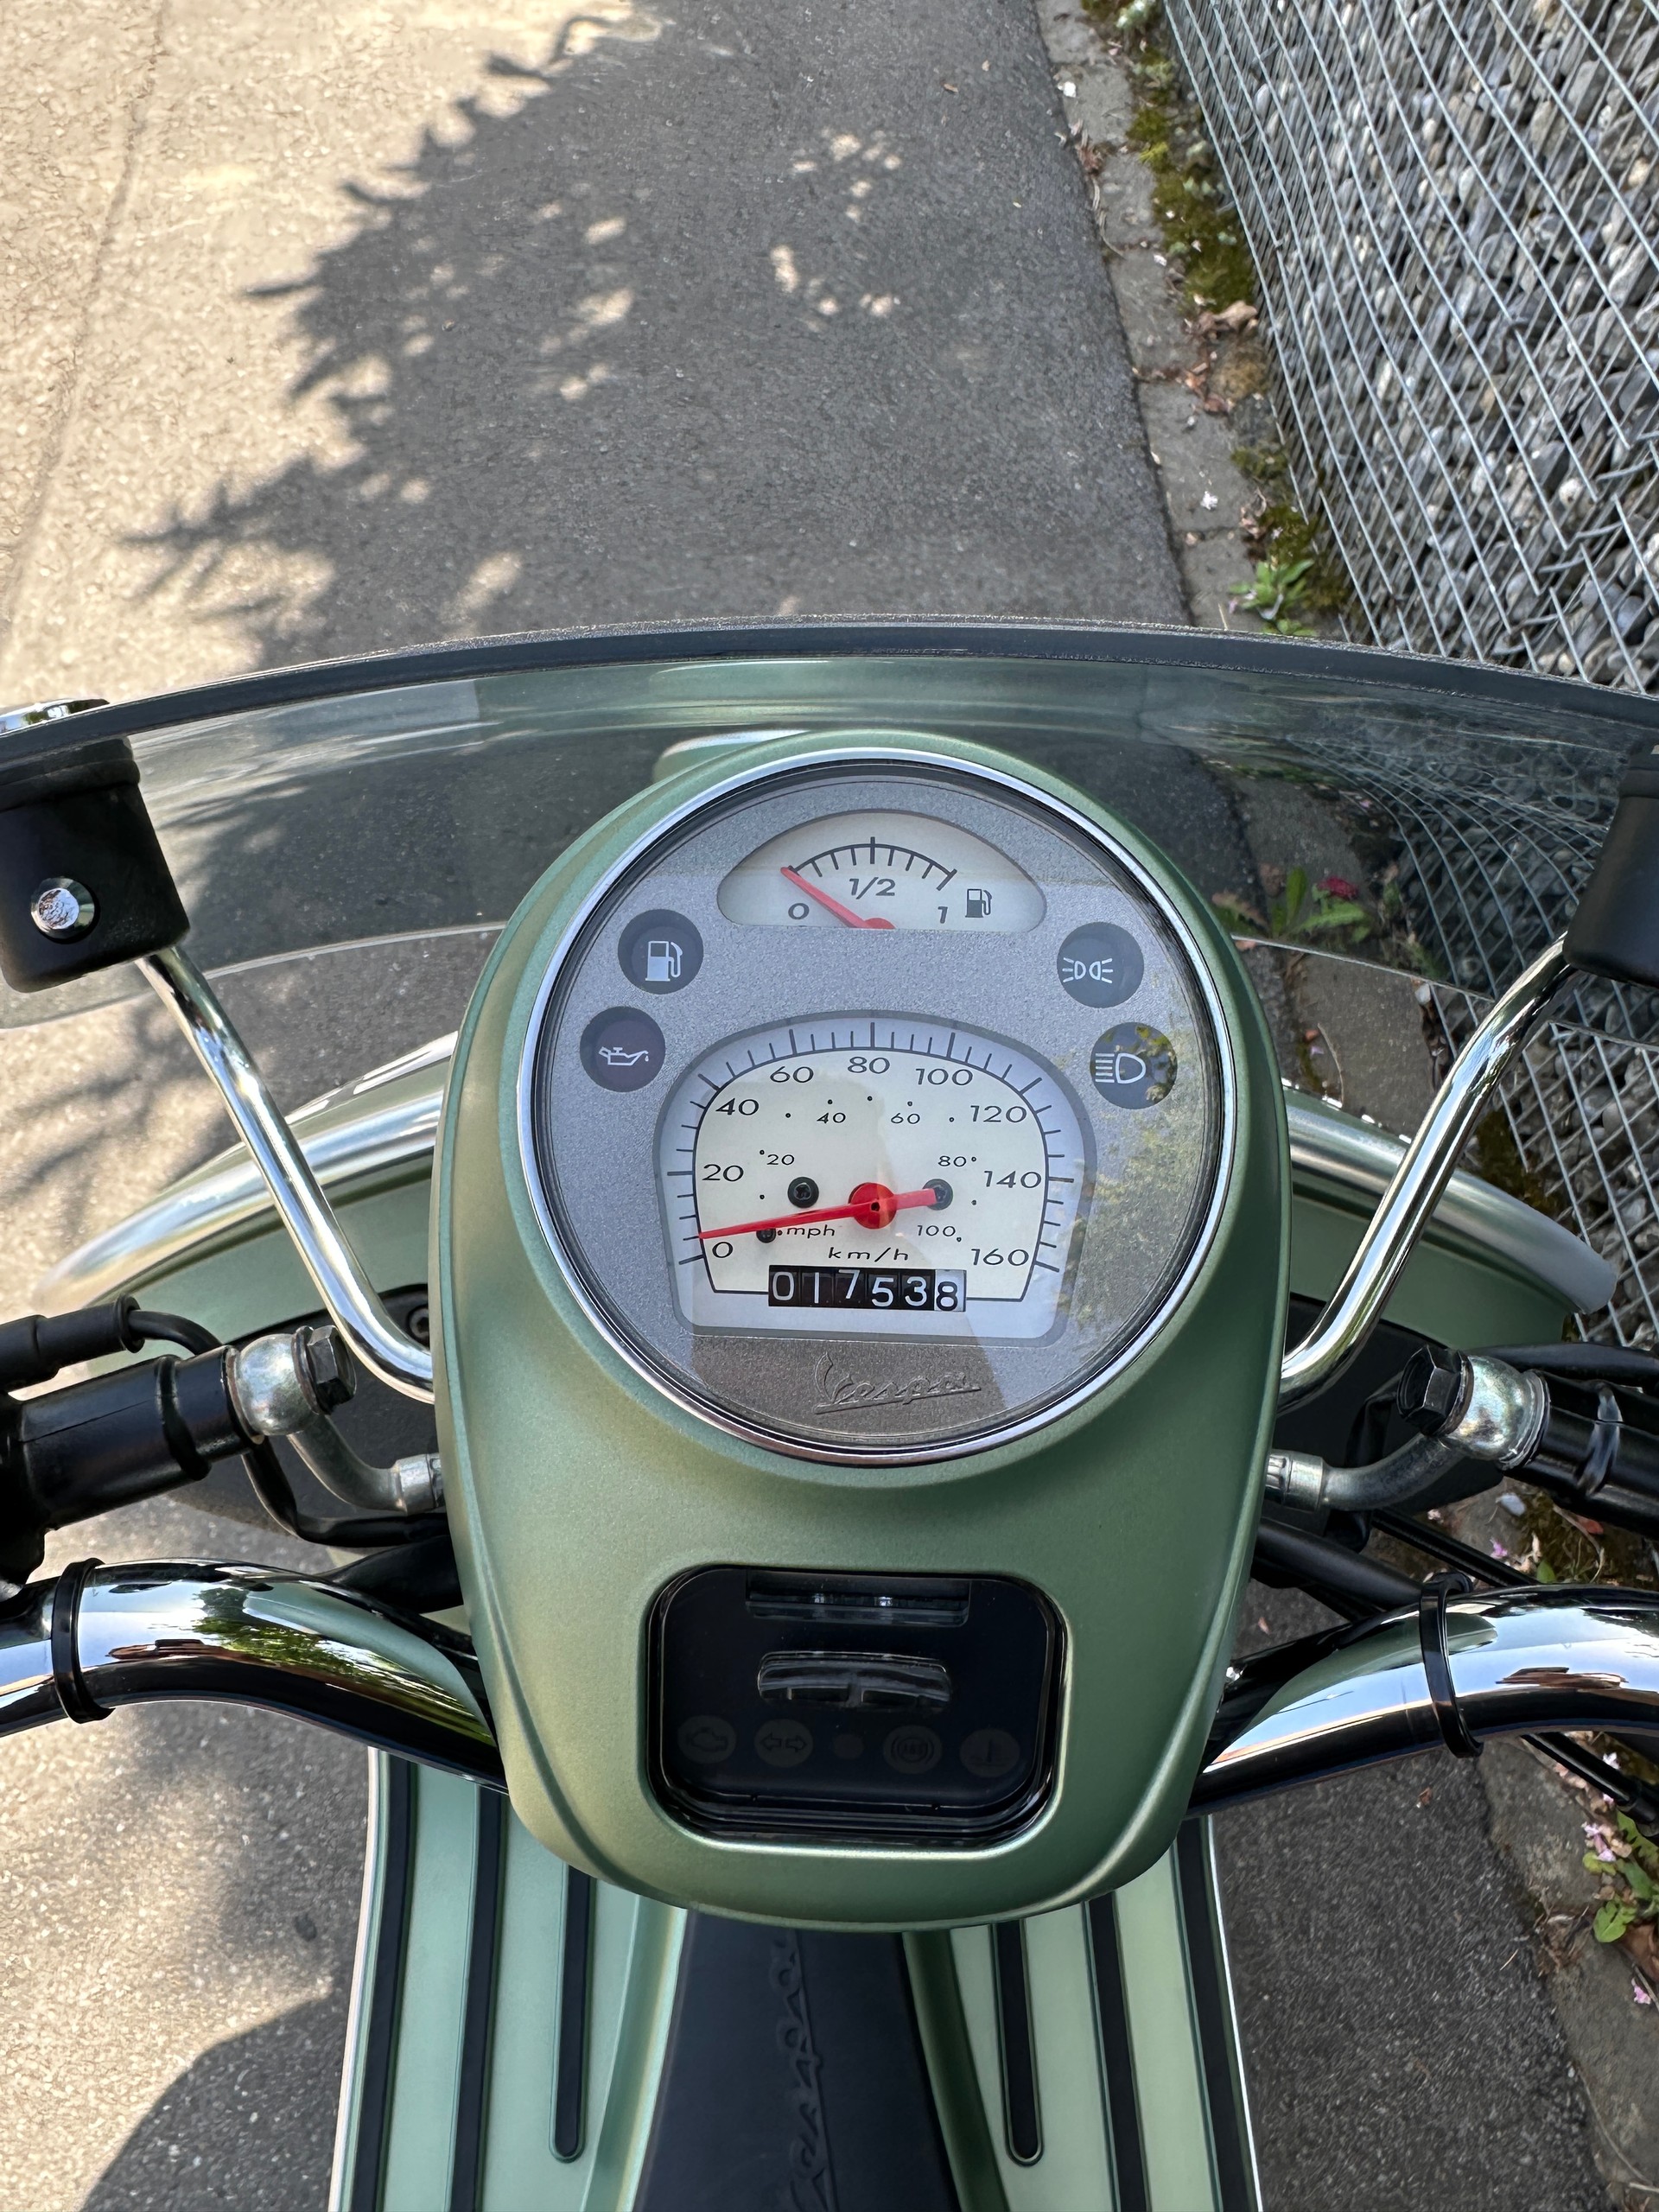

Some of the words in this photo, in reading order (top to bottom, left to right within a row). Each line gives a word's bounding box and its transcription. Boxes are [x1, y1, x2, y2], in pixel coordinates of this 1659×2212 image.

[849, 876, 896, 900] 1/2
[787, 902, 810, 920] 0
[937, 906, 949, 924] 1
[769, 1065, 814, 1084] 60
[847, 1056, 891, 1075] 80
[915, 1068, 973, 1086] 100
[715, 1097, 760, 1116] 40
[969, 1105, 1027, 1123] 120
[816, 1112, 847, 1124] 40
[890, 1112, 921, 1124] 60
[766, 1154, 795, 1166] 20
[938, 1155, 967, 1167] 80
[701, 1164, 744, 1182] 20
[983, 1170, 1042, 1189] 140
[786, 1224, 836, 1239] mph
[917, 1224, 957, 1237] 100
[711, 1241, 734, 1259] 0
[828, 1246, 909, 1263] km/h
[970, 1248, 1030, 1267] 160
[772, 1268, 960, 1312] 017538
[812, 1351, 982, 1414] Vespa
